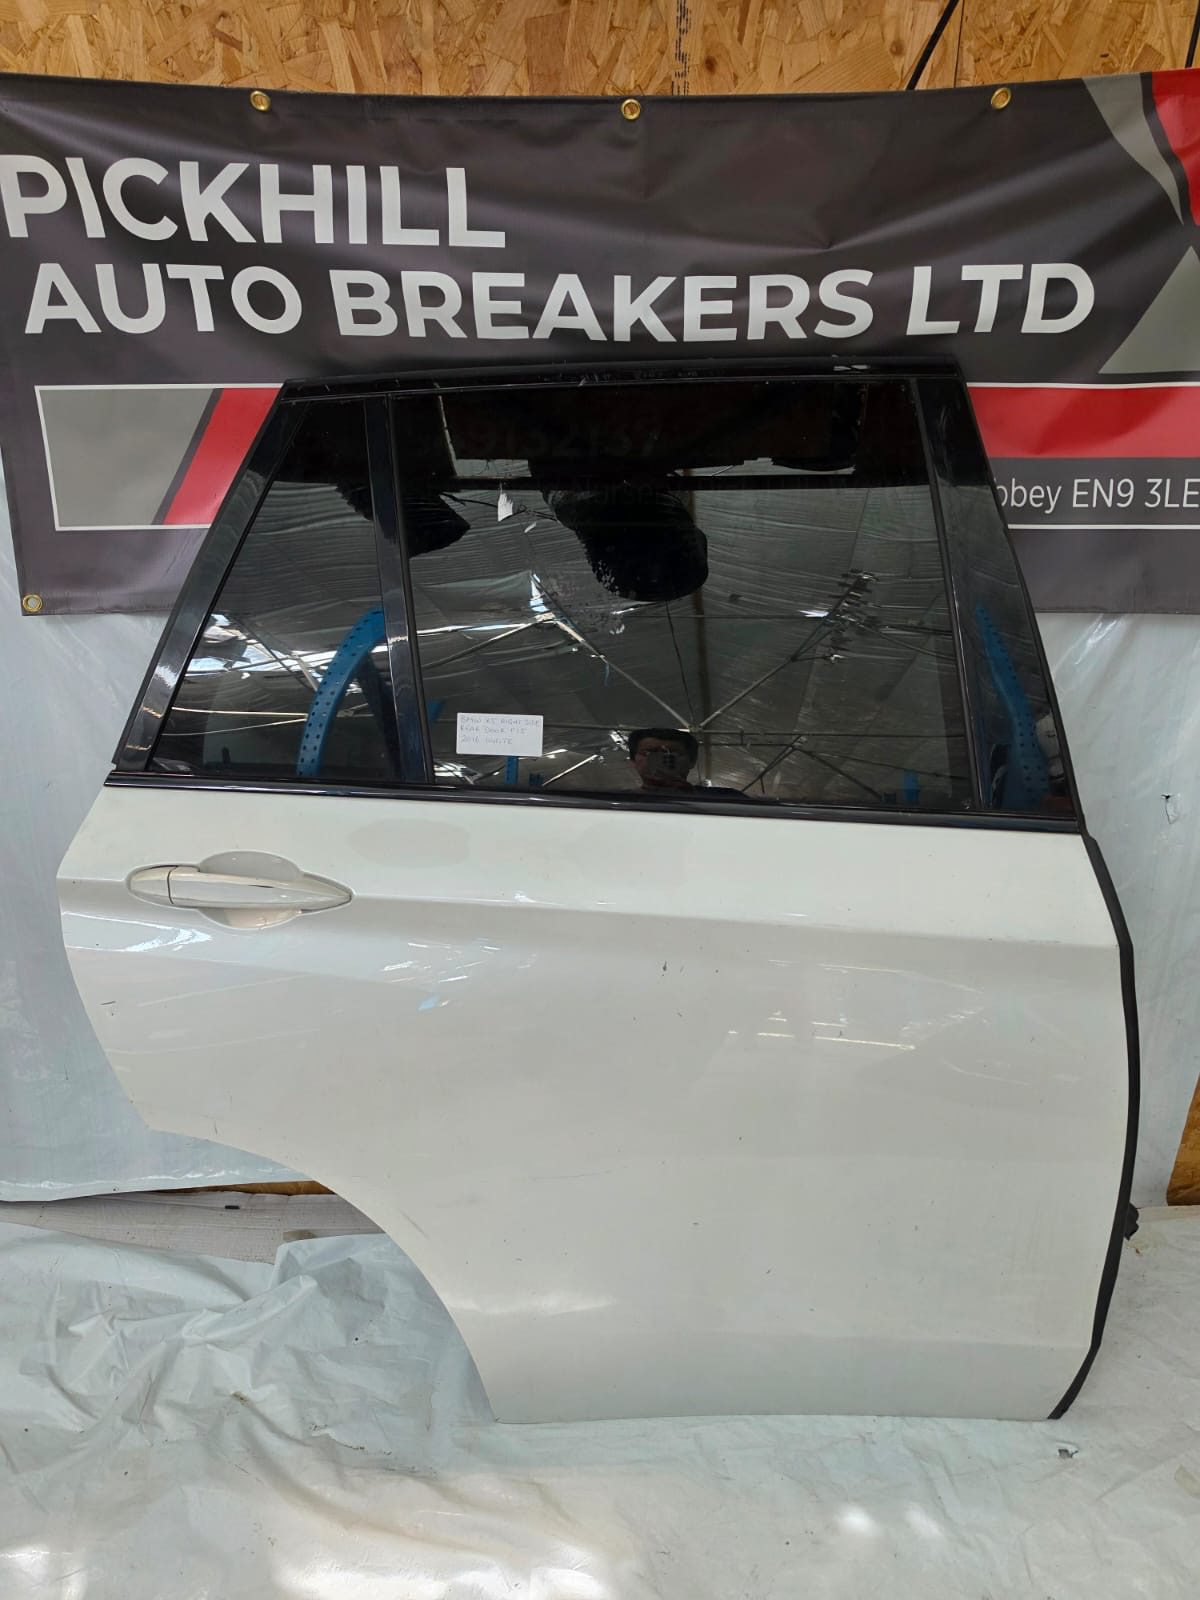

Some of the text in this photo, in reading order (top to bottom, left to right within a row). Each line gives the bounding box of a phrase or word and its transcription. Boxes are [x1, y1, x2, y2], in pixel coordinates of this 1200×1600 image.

[0, 154, 506, 248] PICKHILL
[25, 262, 1095, 343] AUTO BREAKERS LTD
[1072, 478, 1135, 508] EN9
[1144, 478, 1200, 508] 3LE
